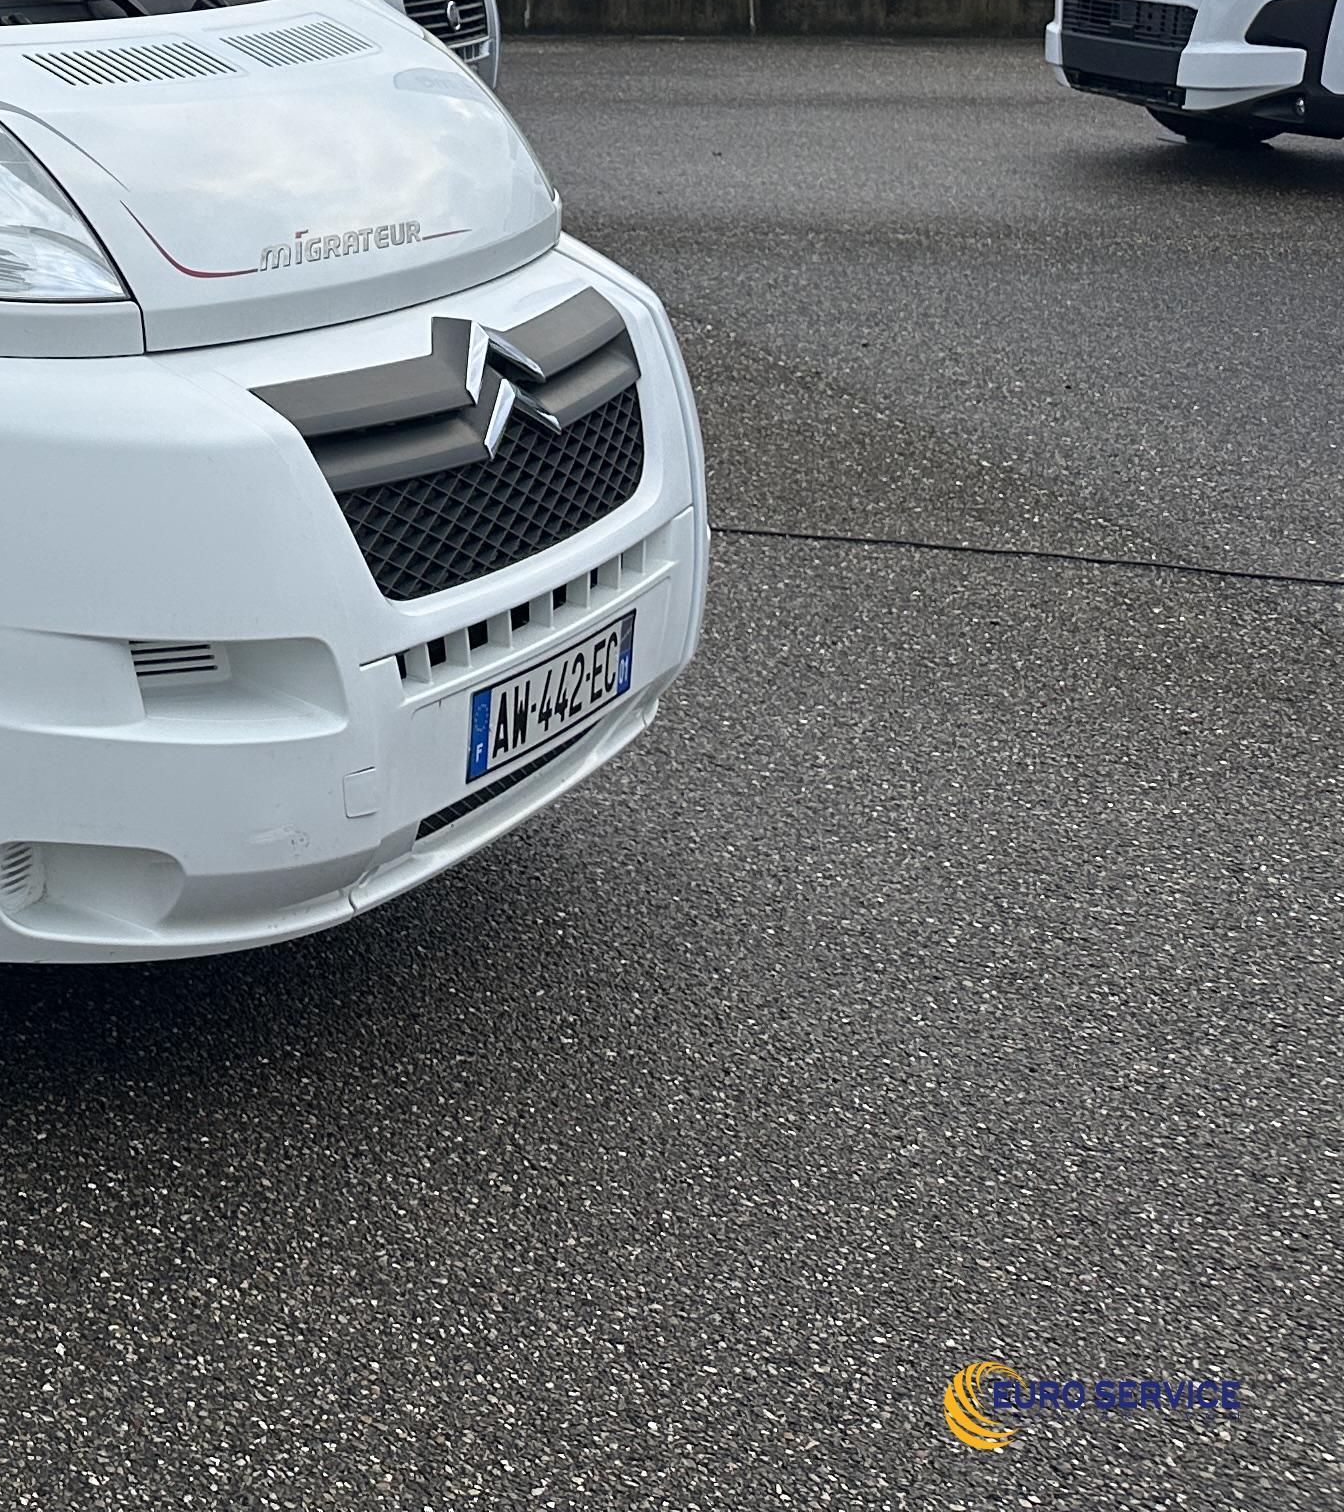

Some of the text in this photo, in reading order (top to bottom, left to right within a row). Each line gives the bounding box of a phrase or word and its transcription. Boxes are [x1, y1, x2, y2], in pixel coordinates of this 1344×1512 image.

[475, 631, 629, 763] F AW-442-EC 01
